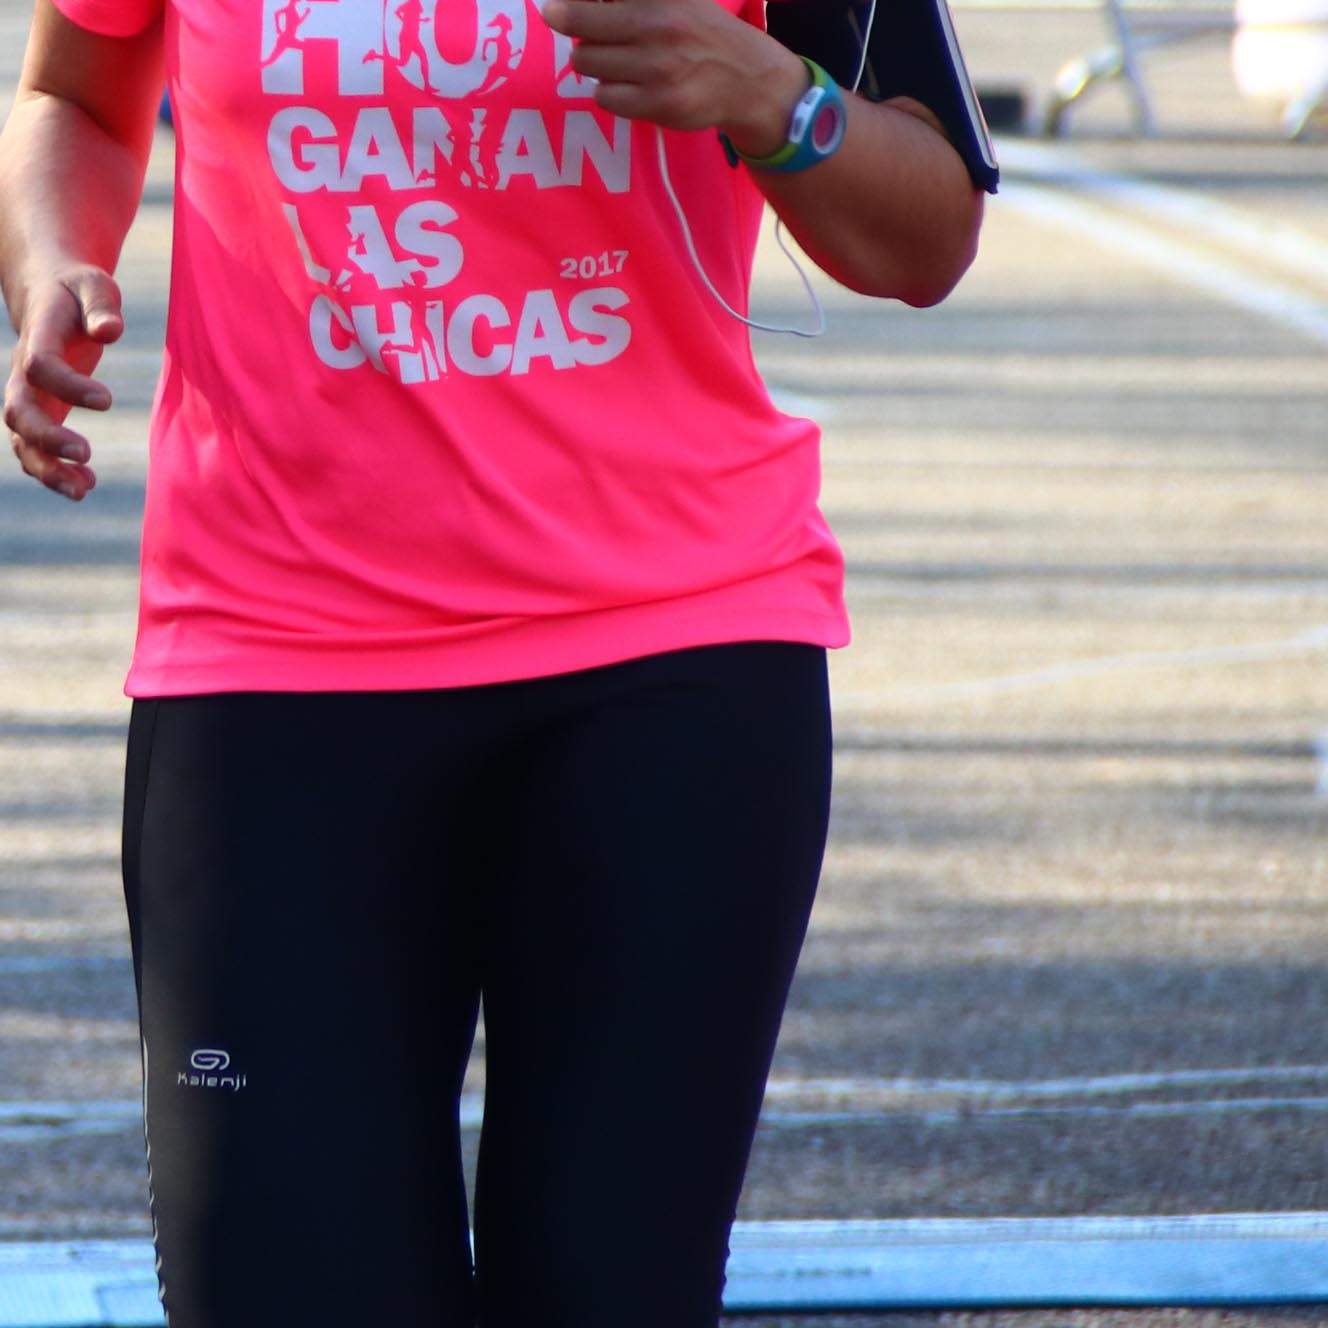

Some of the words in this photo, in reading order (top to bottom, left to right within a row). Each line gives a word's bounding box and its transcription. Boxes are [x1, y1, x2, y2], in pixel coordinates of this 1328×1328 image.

[266, 105, 631, 195] GANAN
[283, 200, 464, 293] LAS
[560, 249, 628, 280] 2017
[309, 285, 633, 384] CHICAS
[177, 1072, 247, 1091] Kalenji
